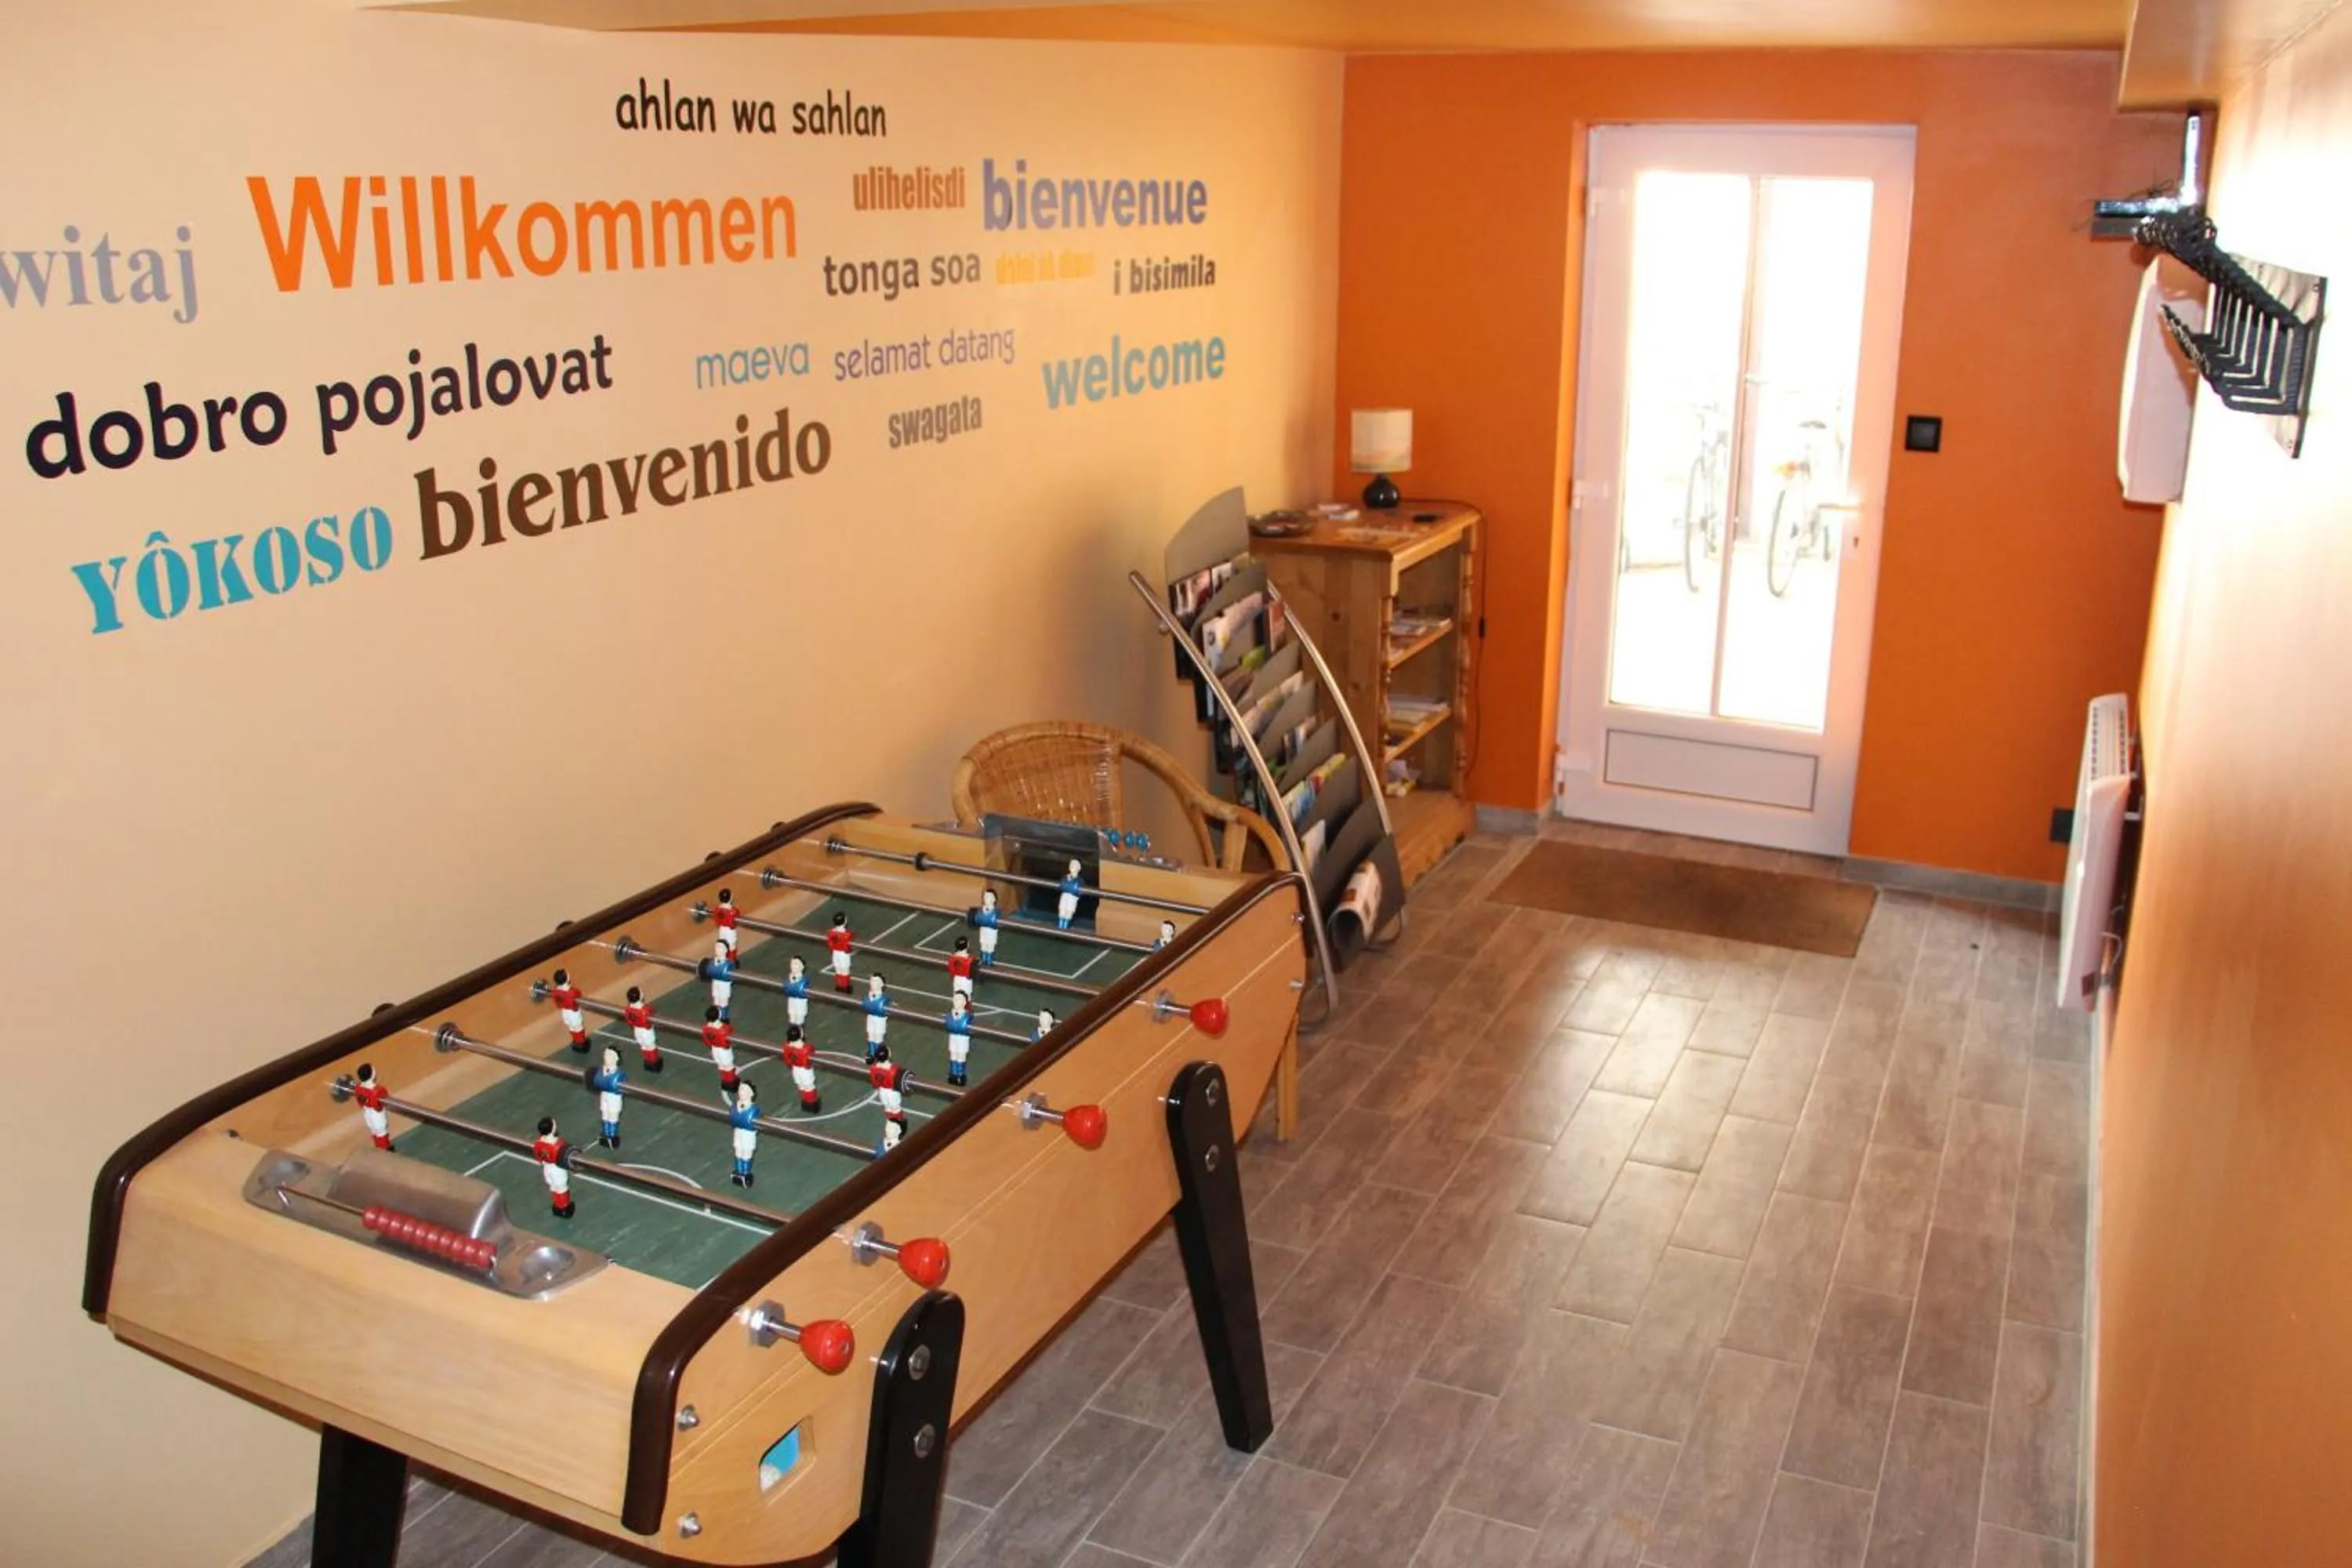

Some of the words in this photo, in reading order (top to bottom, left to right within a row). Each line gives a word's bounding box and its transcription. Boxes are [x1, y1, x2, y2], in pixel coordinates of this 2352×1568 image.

[615, 75, 717, 133] ahlan
[731, 99, 778, 135] wa
[791, 89, 887, 138] sahlan
[852, 165, 965, 212] ulihelisdi
[982, 158, 1208, 231] bienvenue
[245, 175, 797, 293] Willkommen
[0, 224, 199, 325] witaj
[823, 255, 920, 301] tonga
[930, 252, 982, 287] soa
[1129, 254, 1216, 294] bisimila
[695, 342, 811, 390] maeva
[833, 333, 932, 383] selamat
[938, 328, 1016, 365] datang
[1041, 334, 1226, 410] welcome
[25, 380, 289, 480] dobro
[315, 334, 613, 456] pojalovat
[887, 394, 982, 449] swagata
[413, 407, 832, 561] bienvenido
[71, 506, 394, 635] YÔKOSO
